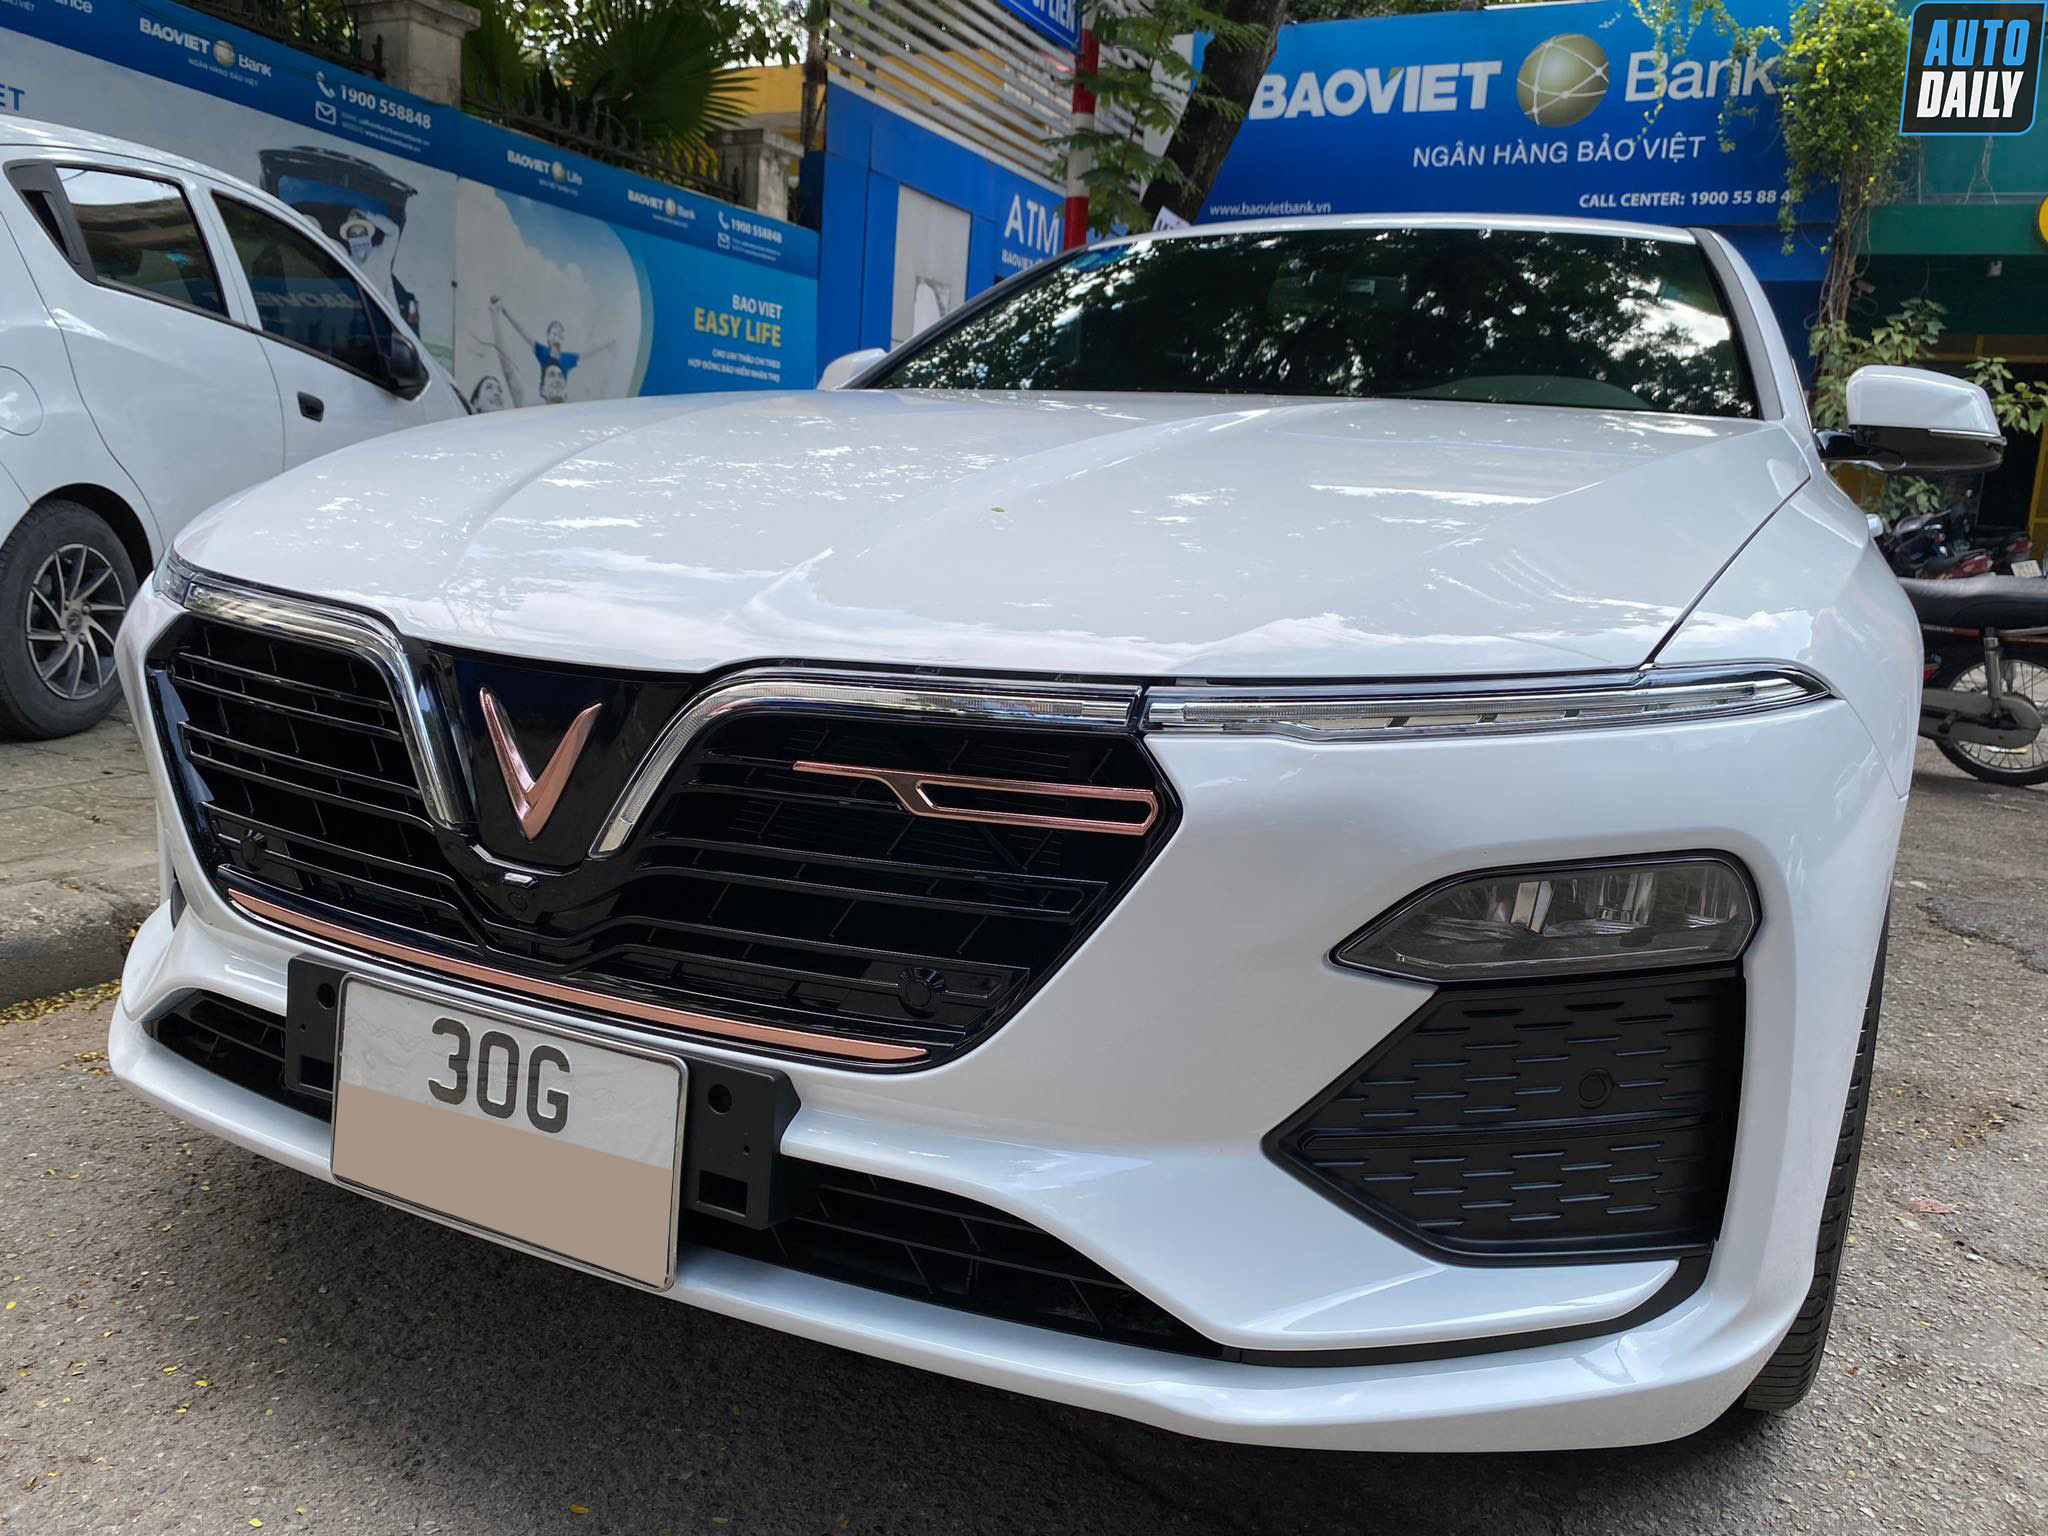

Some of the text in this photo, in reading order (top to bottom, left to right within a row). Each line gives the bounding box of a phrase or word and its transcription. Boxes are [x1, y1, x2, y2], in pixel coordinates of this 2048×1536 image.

[139, 17, 272, 78] BAOVIET Bank
[1248, 49, 1778, 120] BAOVIET Bank
[340, 84, 377, 111] 1900
[379, 98, 432, 130] 558848
[1413, 141, 1486, 168] NGÂN
[1494, 137, 1568, 165] HÀNG
[1644, 131, 1707, 163] VIỆT
[1209, 200, 1332, 217] www.baovietbank.vn
[1579, 193, 1617, 208] CALL
[1620, 191, 1685, 208] CENTER:
[1690, 190, 1729, 206] 1900
[1731, 190, 1753, 205] 55
[1756, 189, 1777, 204] 88
[1004, 192, 1060, 257] ATM
[694, 305, 782, 348] EASY LIFE
[732, 293, 783, 321] BAO VIET
[428, 1017, 571, 1134] 30G
